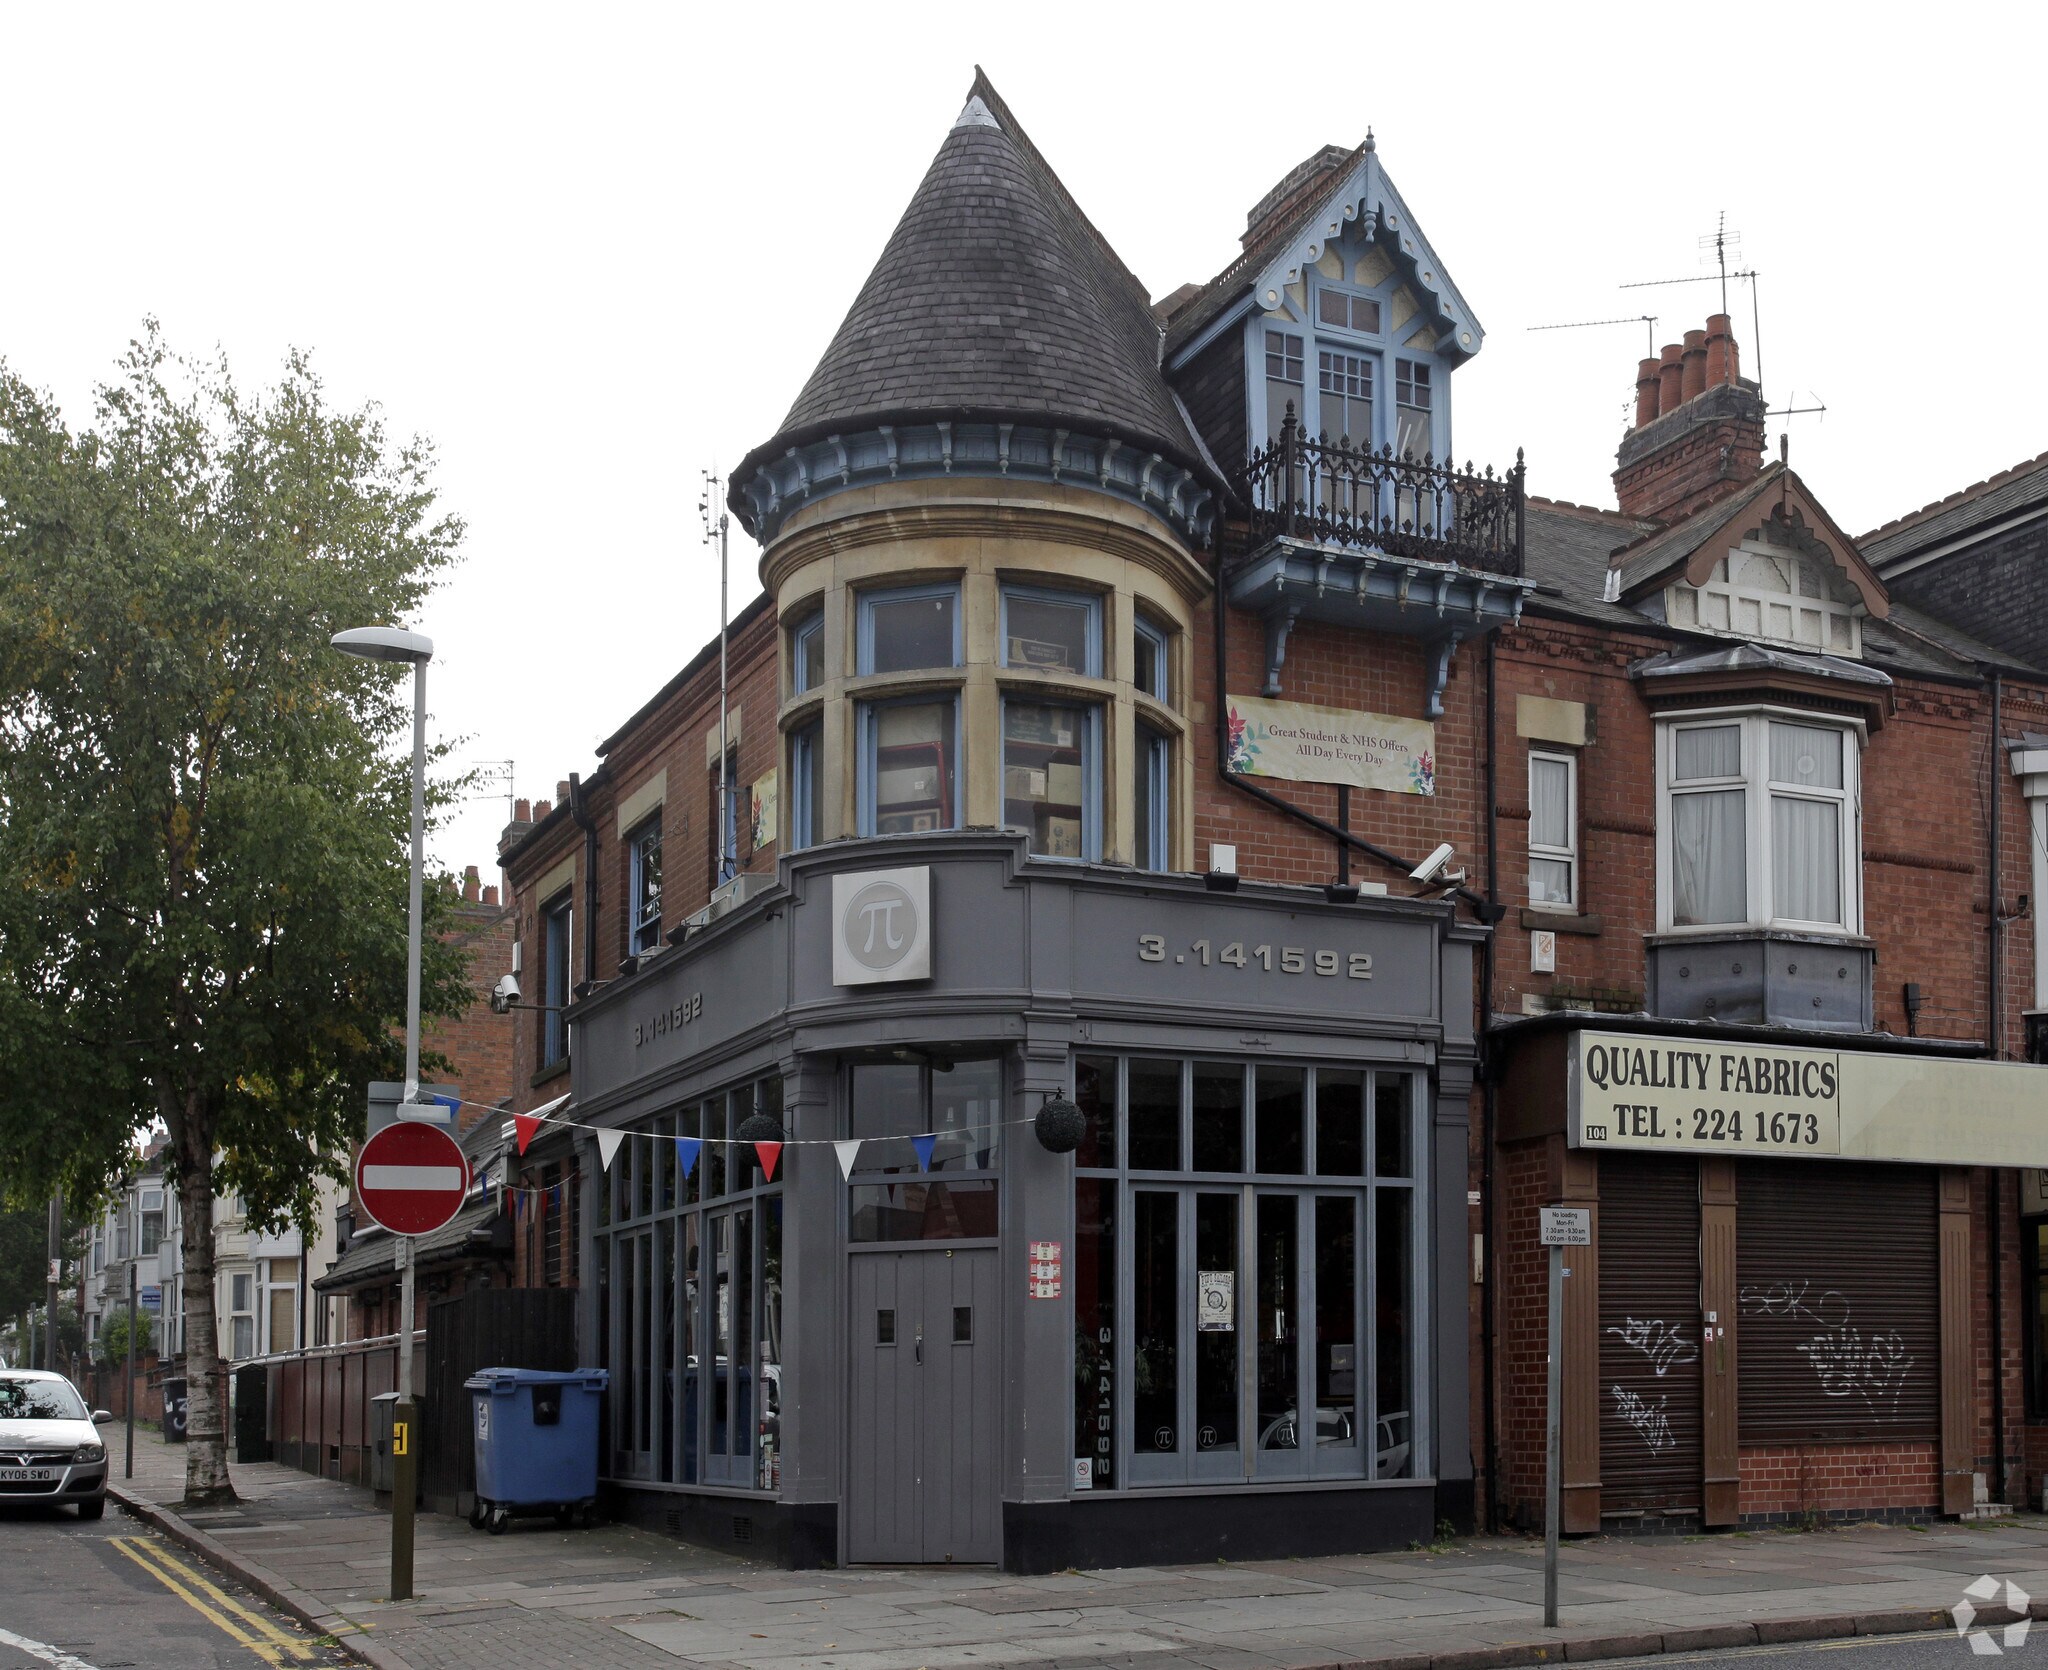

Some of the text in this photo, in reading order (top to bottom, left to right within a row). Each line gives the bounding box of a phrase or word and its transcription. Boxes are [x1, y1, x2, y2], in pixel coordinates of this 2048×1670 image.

[1268, 724, 1409, 753] Great Student & NHS Offers
[1295, 743, 1384, 767] All Day Every Day
[1138, 933, 1374, 980] 3.141592
[632, 992, 702, 1046] 3.141592
[1586, 1044, 1711, 1091] QUALITY
[1719, 1054, 1836, 1100] FABRICS
[1587, 1126, 1606, 1140] 104
[1613, 1103, 1667, 1138] TEL
[1692, 1108, 1744, 1141] 224
[1755, 1111, 1819, 1145] 1673
[1560, 1211, 1578, 1220] loading
[1098, 1326, 1111, 1475] 3.141592
[0, 1470, 50, 1480] KY06 SWO
